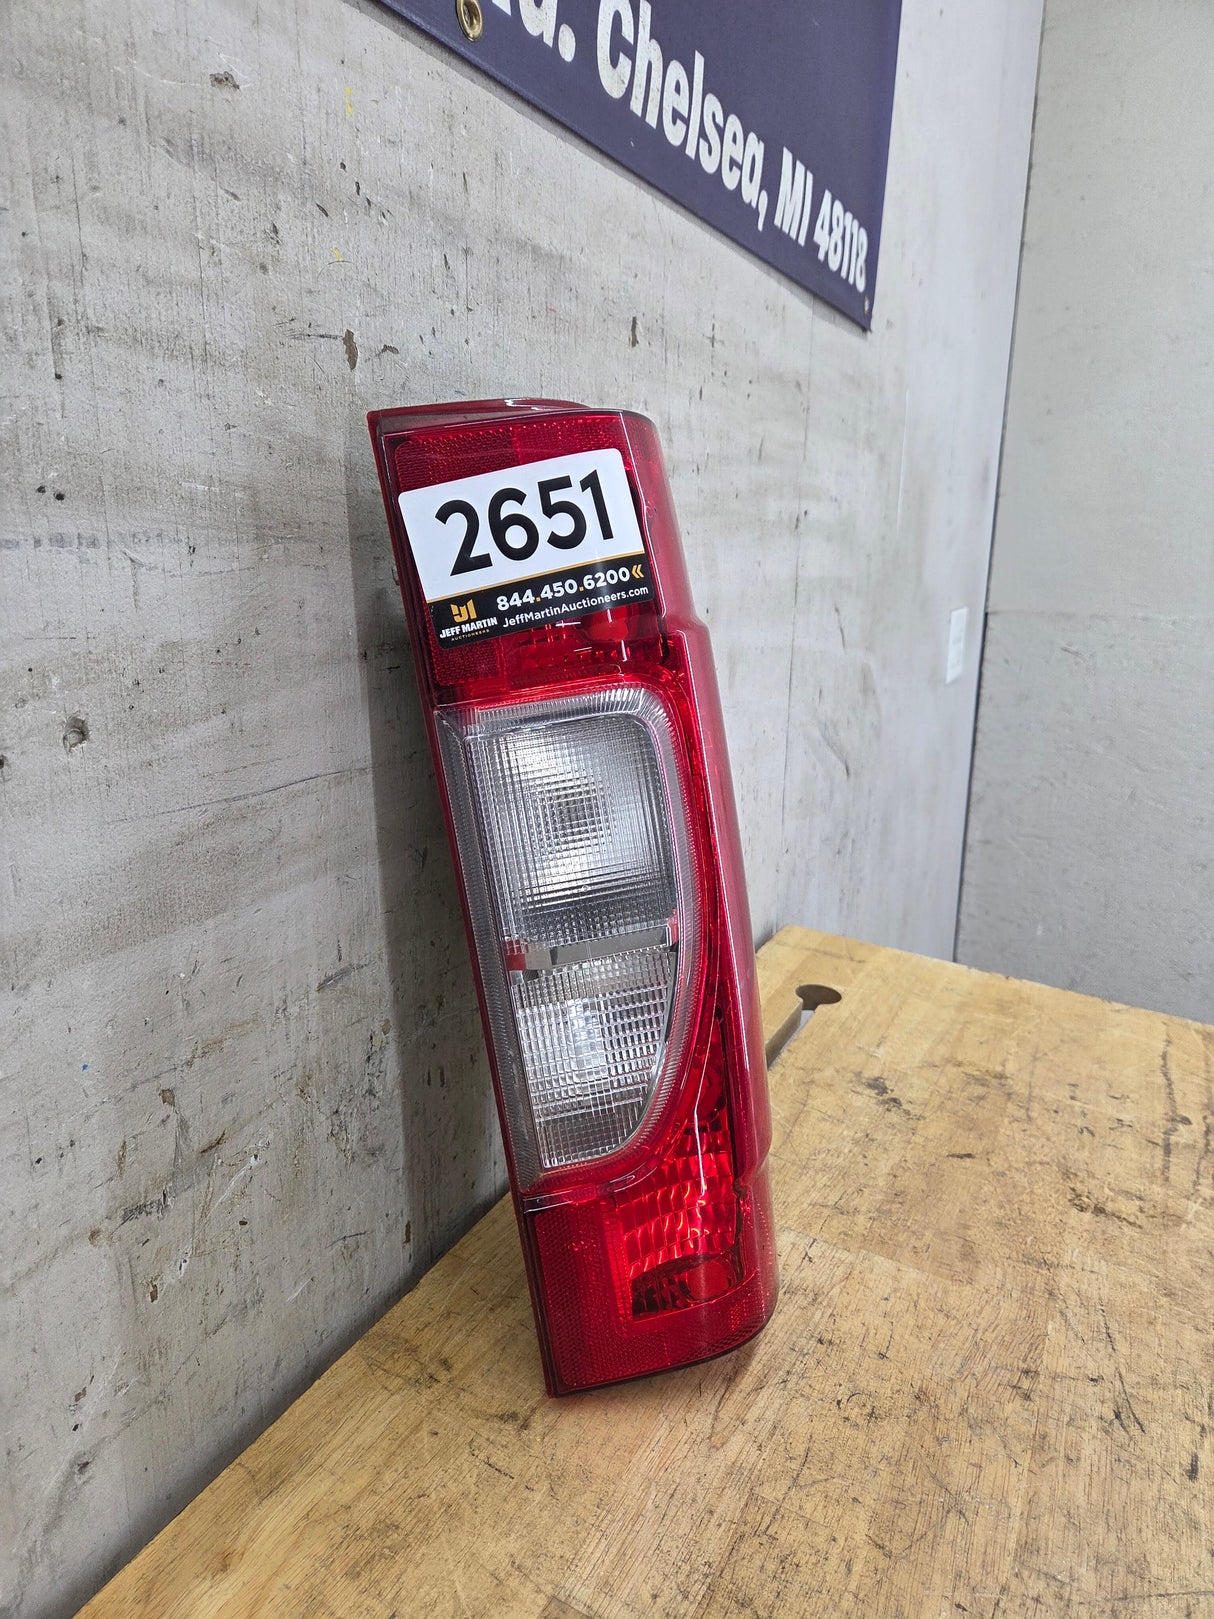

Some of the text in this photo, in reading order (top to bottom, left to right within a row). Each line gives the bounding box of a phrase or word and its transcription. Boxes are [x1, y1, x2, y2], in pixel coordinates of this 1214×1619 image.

[597, 0, 768, 232] Chelsea,
[774, 146, 813, 247] MI
[813, 189, 868, 293] 48118
[435, 469, 614, 577] 2651
[496, 567, 630, 611] 844.450.6200
[502, 586, 649, 628] JeffMartinAuctioneers.com
[440, 617, 498, 639] JEFF MARTIN
